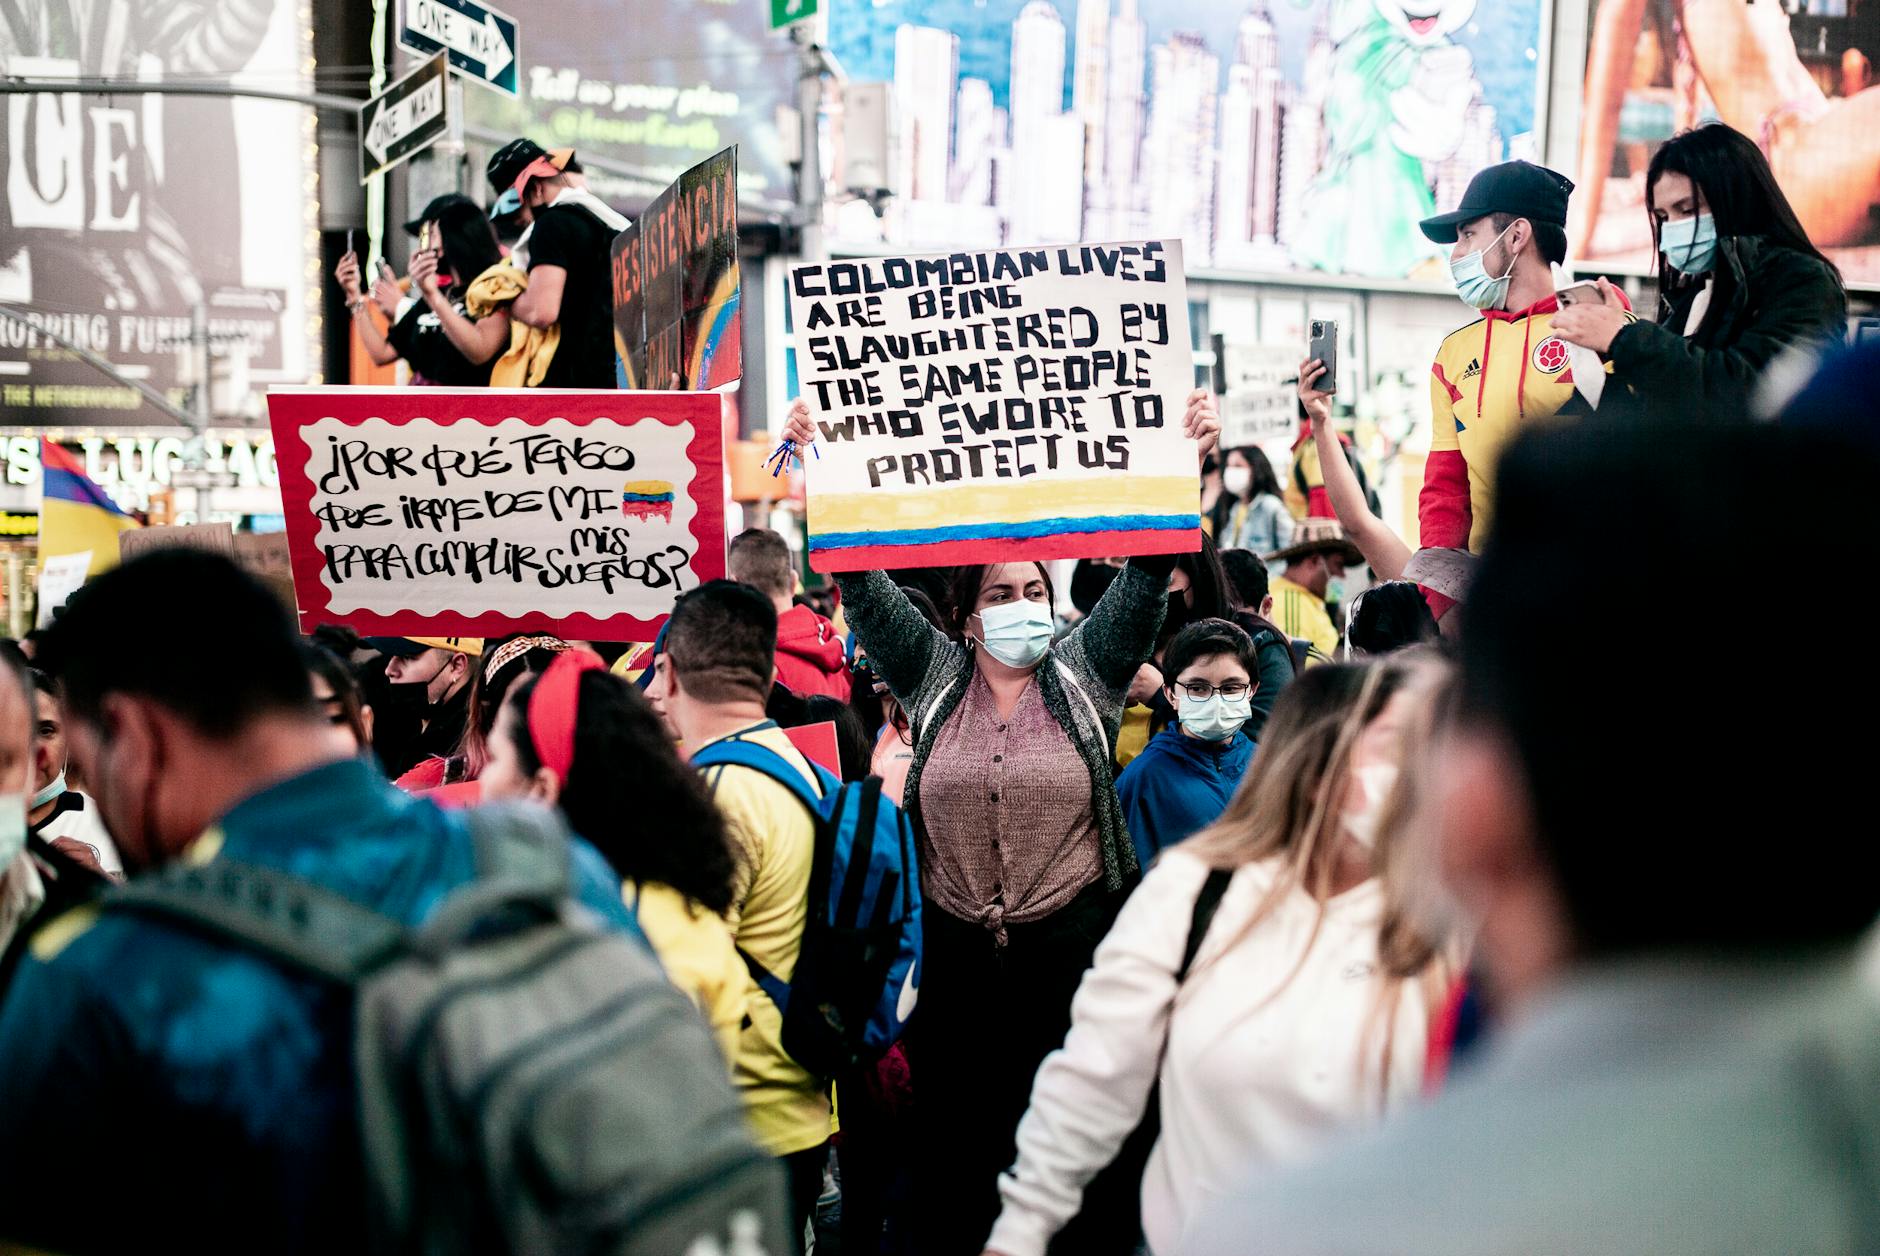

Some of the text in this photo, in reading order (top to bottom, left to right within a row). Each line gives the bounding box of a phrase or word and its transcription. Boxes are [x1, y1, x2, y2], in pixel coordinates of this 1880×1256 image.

[417, 0, 452, 41] ONE
[373, 109, 398, 149] ONE
[613, 165, 738, 309] RESISTENCIA
[793, 241, 1166, 297] COLOMBIAN LIVES
[807, 285, 1022, 330] ARE BEING
[809, 303, 1169, 371] SLAUGHTERED BY
[807, 349, 1152, 411] THE SAME PEOPLE
[817, 391, 1164, 443] WHO SWORE TO
[320, 433, 635, 495] ¿POR QUÉ TENGO
[866, 434, 1130, 488] PROTECT US
[316, 501, 392, 532] QUE
[484, 490, 543, 519] DE
[548, 486, 618, 522] MI
[325, 544, 416, 584] PARA
